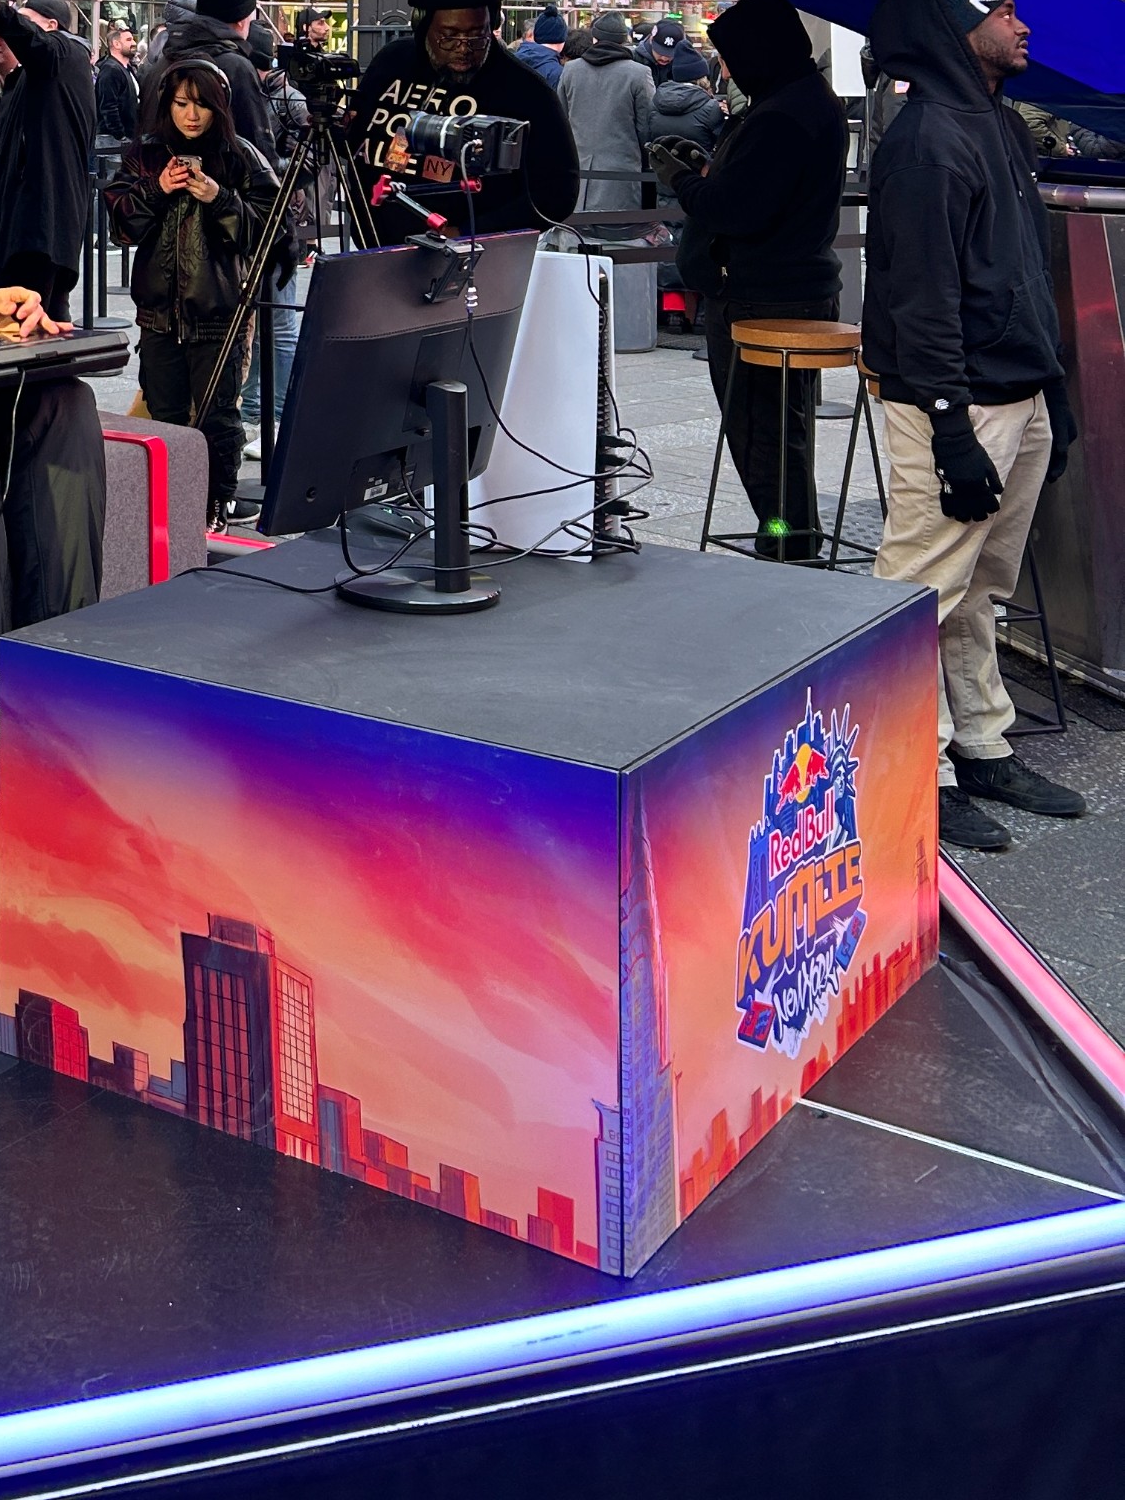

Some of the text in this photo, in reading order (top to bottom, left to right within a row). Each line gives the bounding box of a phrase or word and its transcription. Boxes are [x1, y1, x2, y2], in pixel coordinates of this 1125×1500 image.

[426, 158, 452, 177] NY
[770, 788, 835, 878] Red Bull
